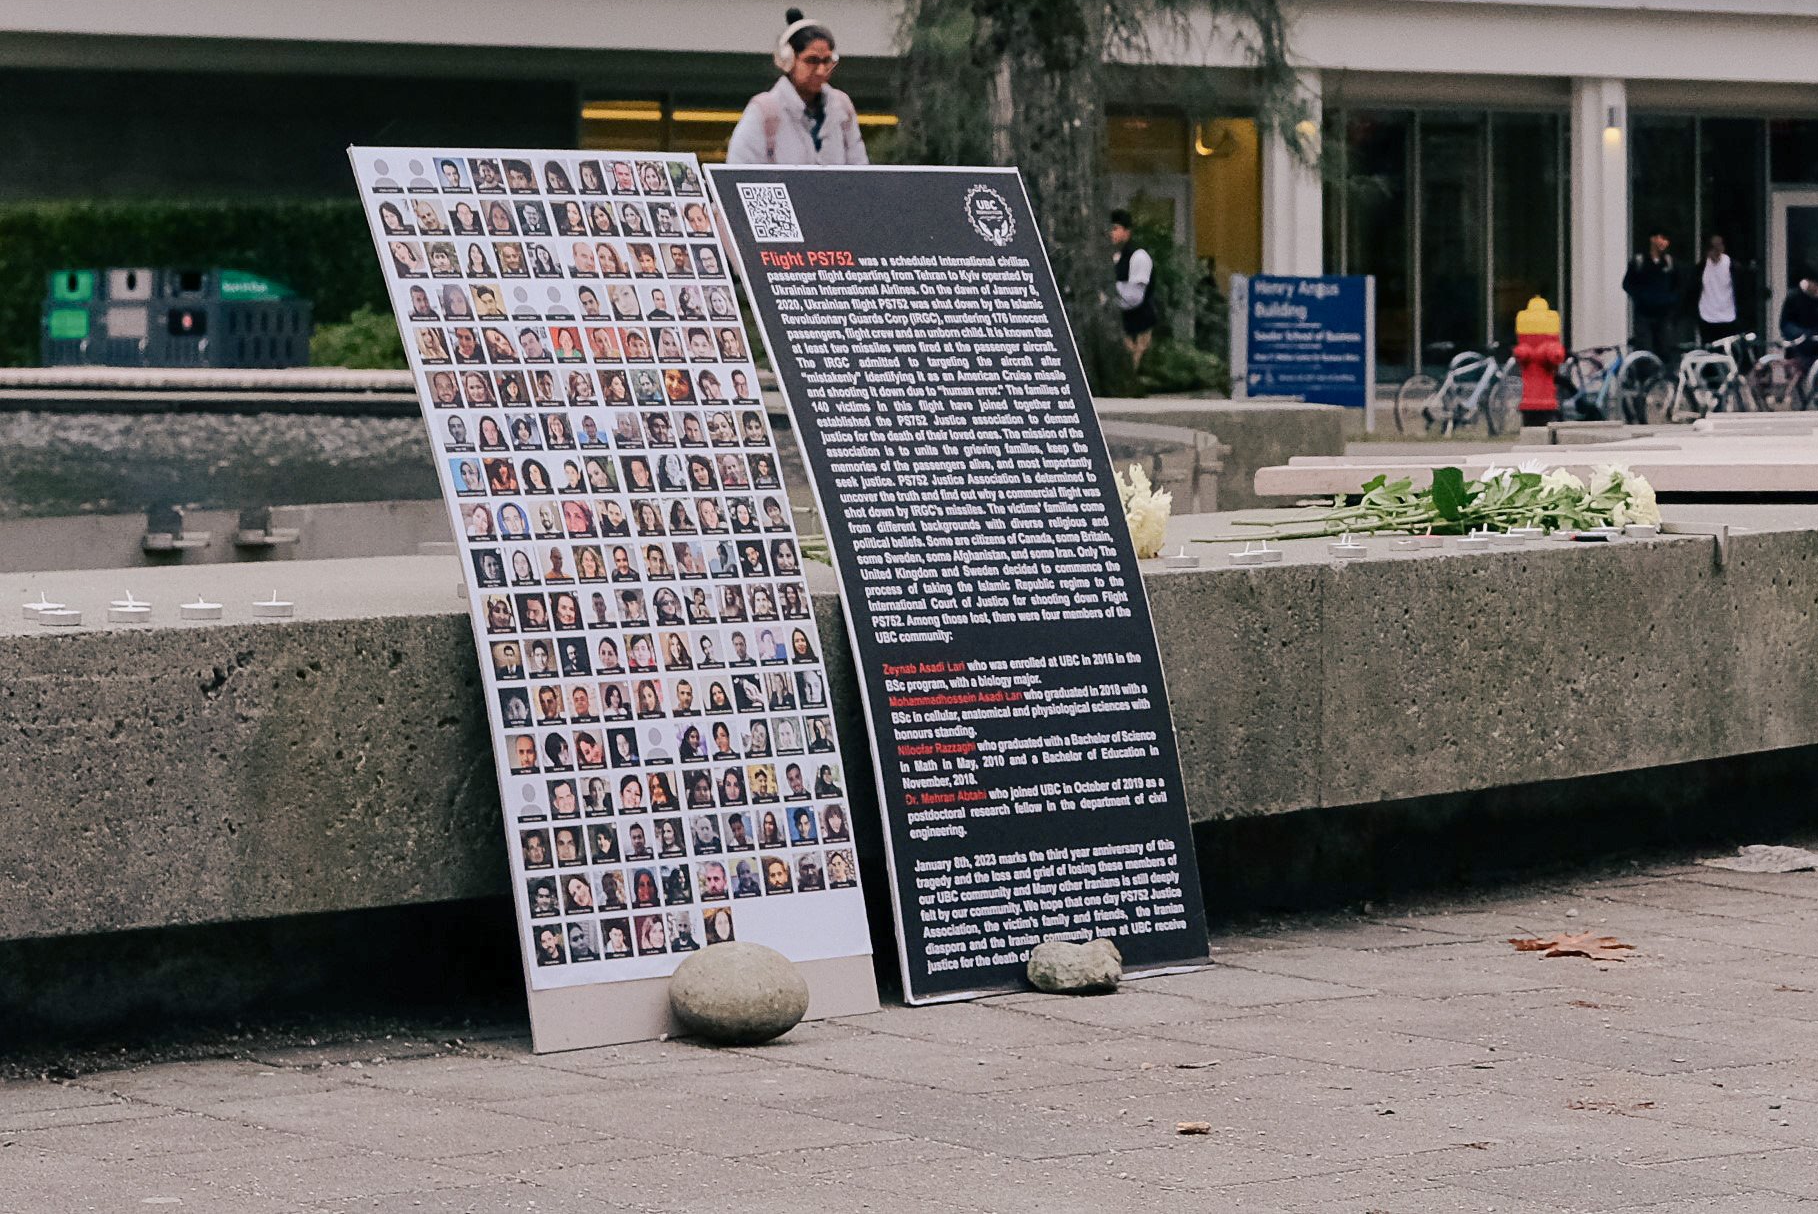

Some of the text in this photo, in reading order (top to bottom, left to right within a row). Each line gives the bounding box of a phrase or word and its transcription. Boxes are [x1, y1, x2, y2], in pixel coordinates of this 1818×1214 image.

[976, 200, 998, 210] UBC
[761, 251, 805, 269] Flight
[807, 251, 855, 265] PS752
[858, 257, 878, 266] was
[880, 257, 888, 266] a
[889, 255, 937, 266] scheduled
[997, 256, 1029, 267] civilian
[767, 269, 1033, 283] passenger flight departing from Tehran to Kyiv operated by
[771, 284, 818, 295] Ukrainian
[819, 284, 879, 295] International
[880, 284, 919, 295] Airlines.
[919, 283, 935, 294] On
[935, 284, 952, 295] the
[953, 284, 979, 294] dawn
[980, 284, 990, 295] of
[993, 285, 1027, 297] January
[1255, 280, 1340, 300] Henry Angus
[776, 298, 1043, 312] 2020, Ukrainian flight PS752 was shut down by the Islamic
[1254, 301, 1307, 321] Building
[781, 313, 847, 326] Revolutionary
[848, 313, 884, 324] Guards
[884, 313, 908, 326] Corp
[944, 313, 991, 325] murdering
[811, 401, 829, 412] 140
[835, 401, 870, 412] victims
[893, 400, 913, 411] this
[918, 400, 944, 413] flight
[949, 400, 973, 410] have
[978, 399, 1008, 412] joined
[1013, 399, 1050, 412] together
[1057, 399, 1075, 409] and
[817, 413, 1079, 427] established the PS752 Justice association to demand
[835, 477, 858, 487] seek
[897, 475, 928, 486] PS752
[932, 474, 964, 485] Justice
[967, 473, 1020, 484] Association
[1035, 472, 1084, 483] determined
[1085, 471, 1096, 482] to
[847, 516, 1109, 533] from different backgrounds with diverse religious and
[860, 561, 1120, 581] United Kingdom and Sweden decided to commence the
[865, 576, 1124, 598] process of taking the Islamic Republic regime to the
[868, 591, 1128, 611] International Court of Justice for shooting down Flight
[875, 630, 952, 643] UBC community:
[966, 660, 987, 671] who
[988, 660, 1007, 670] was
[1009, 657, 1046, 669] enrolled
[1047, 656, 1058, 667] at
[1058, 655, 1080, 666] UBC
[1125, 652, 1141, 663] the
[885, 675, 1041, 692] BSc program, with a biology major.
[902, 777, 951, 789] November,
[908, 808, 965, 824] postdoctoral
[970, 805, 1010, 817] research
[1014, 802, 1042, 813] fellow
[1060, 799, 1075, 810] the
[1080, 796, 1130, 810] department
[1134, 793, 1144, 804] of
[1148, 791, 1167, 803] civil
[910, 825, 966, 840] engineering.
[914, 860, 951, 872] January
[974, 854, 996, 866] 2023
[998, 853, 1027, 864] marks
[1028, 851, 1044, 862] the
[1046, 848, 1068, 860] third
[1070, 848, 1090, 861] year
[1092, 843, 1143, 856] anniversary
[1145, 840, 1155, 852] of
[1157, 839, 1175, 850] this
